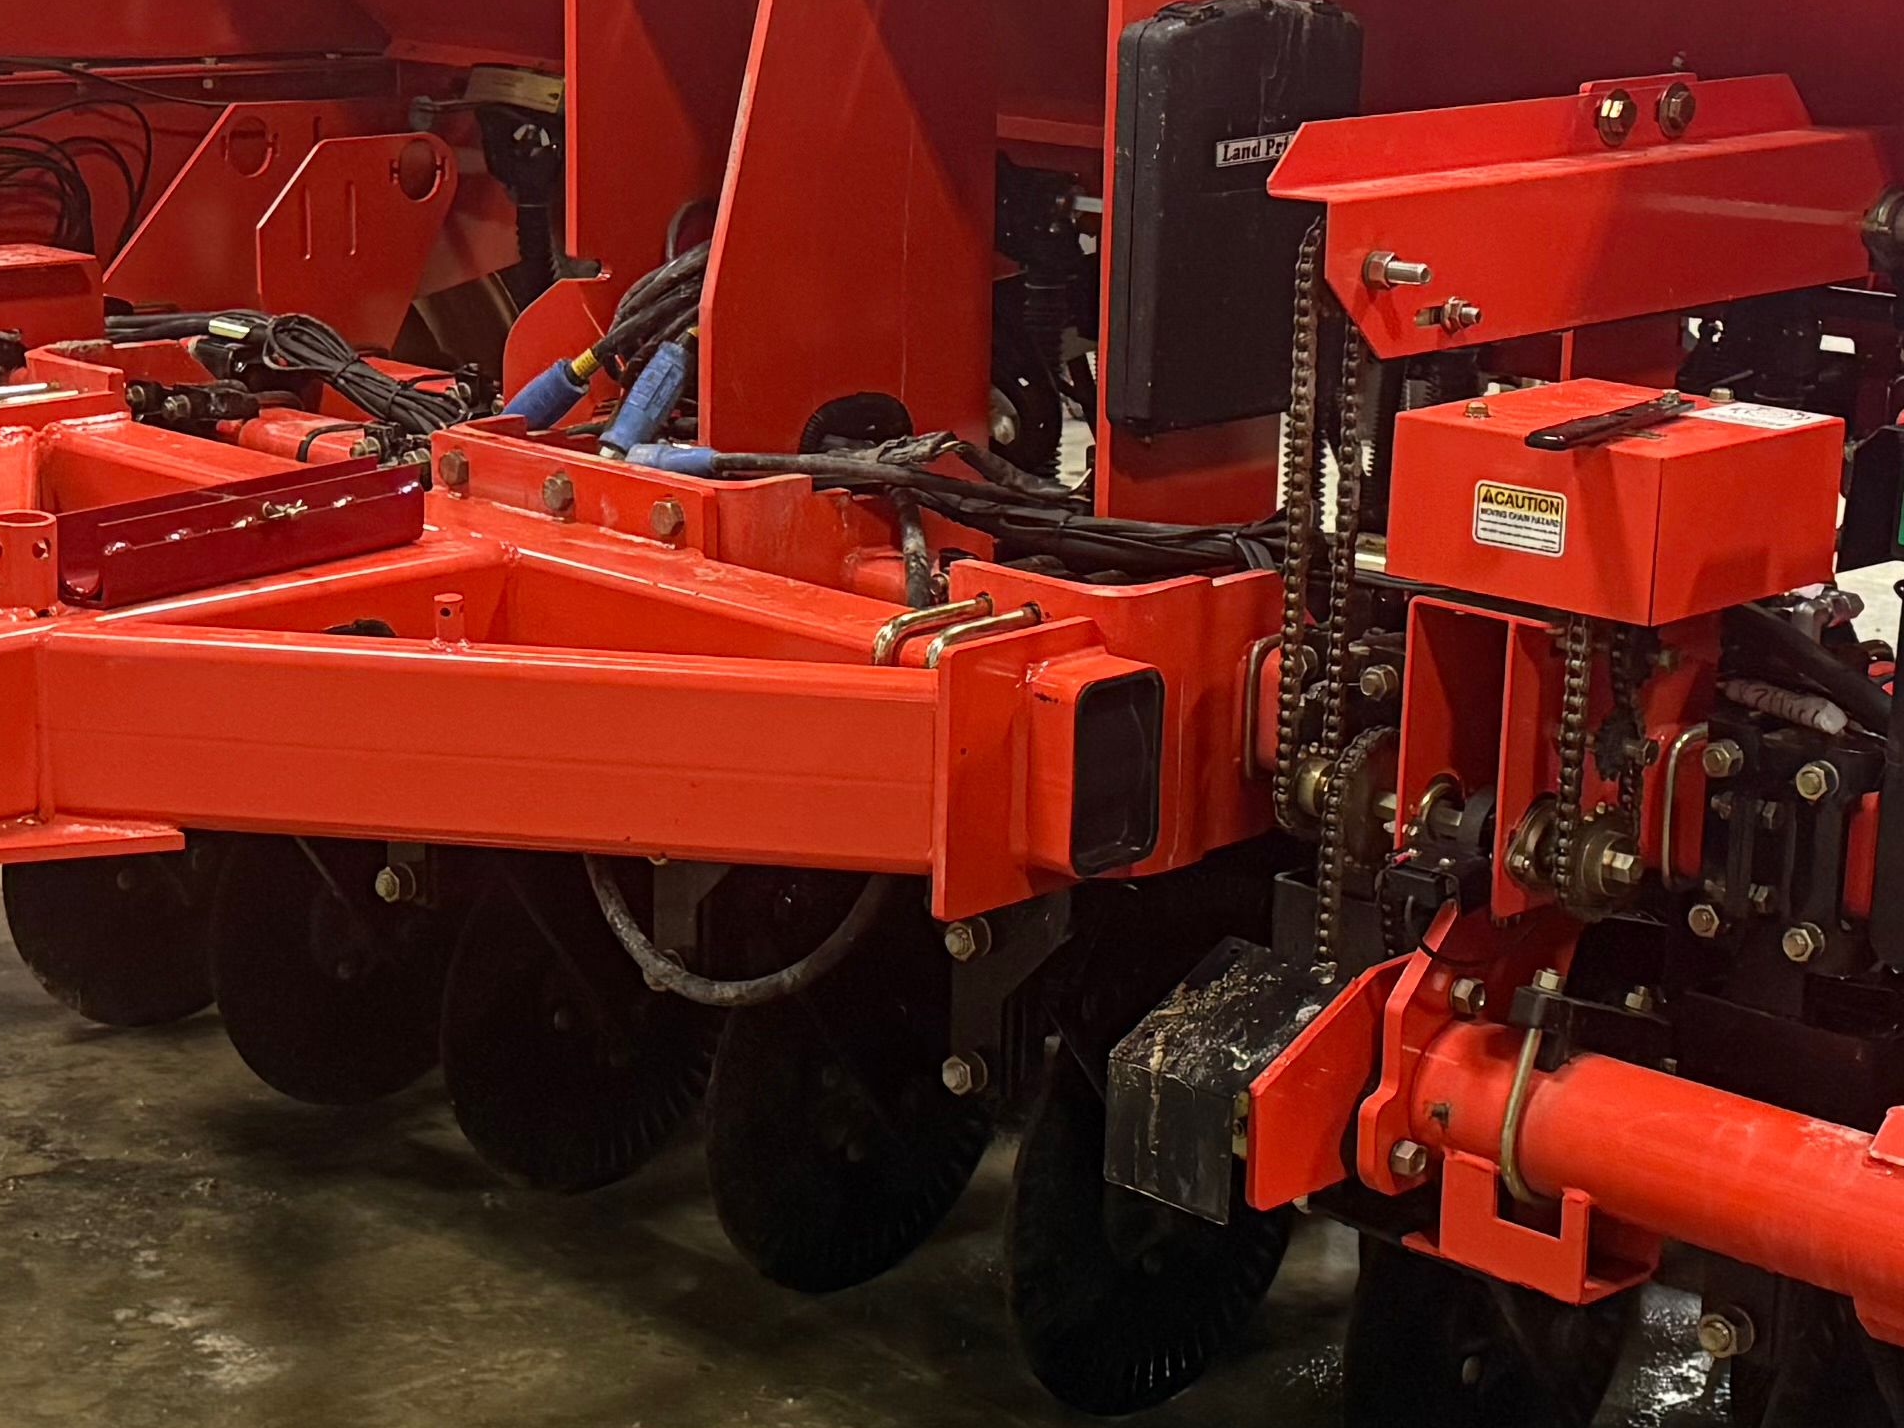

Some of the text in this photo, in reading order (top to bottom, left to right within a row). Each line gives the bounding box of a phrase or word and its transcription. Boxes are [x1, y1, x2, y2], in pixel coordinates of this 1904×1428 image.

[1222, 134, 1291, 162] Land Pri
[1494, 490, 1560, 516] CAUTION
